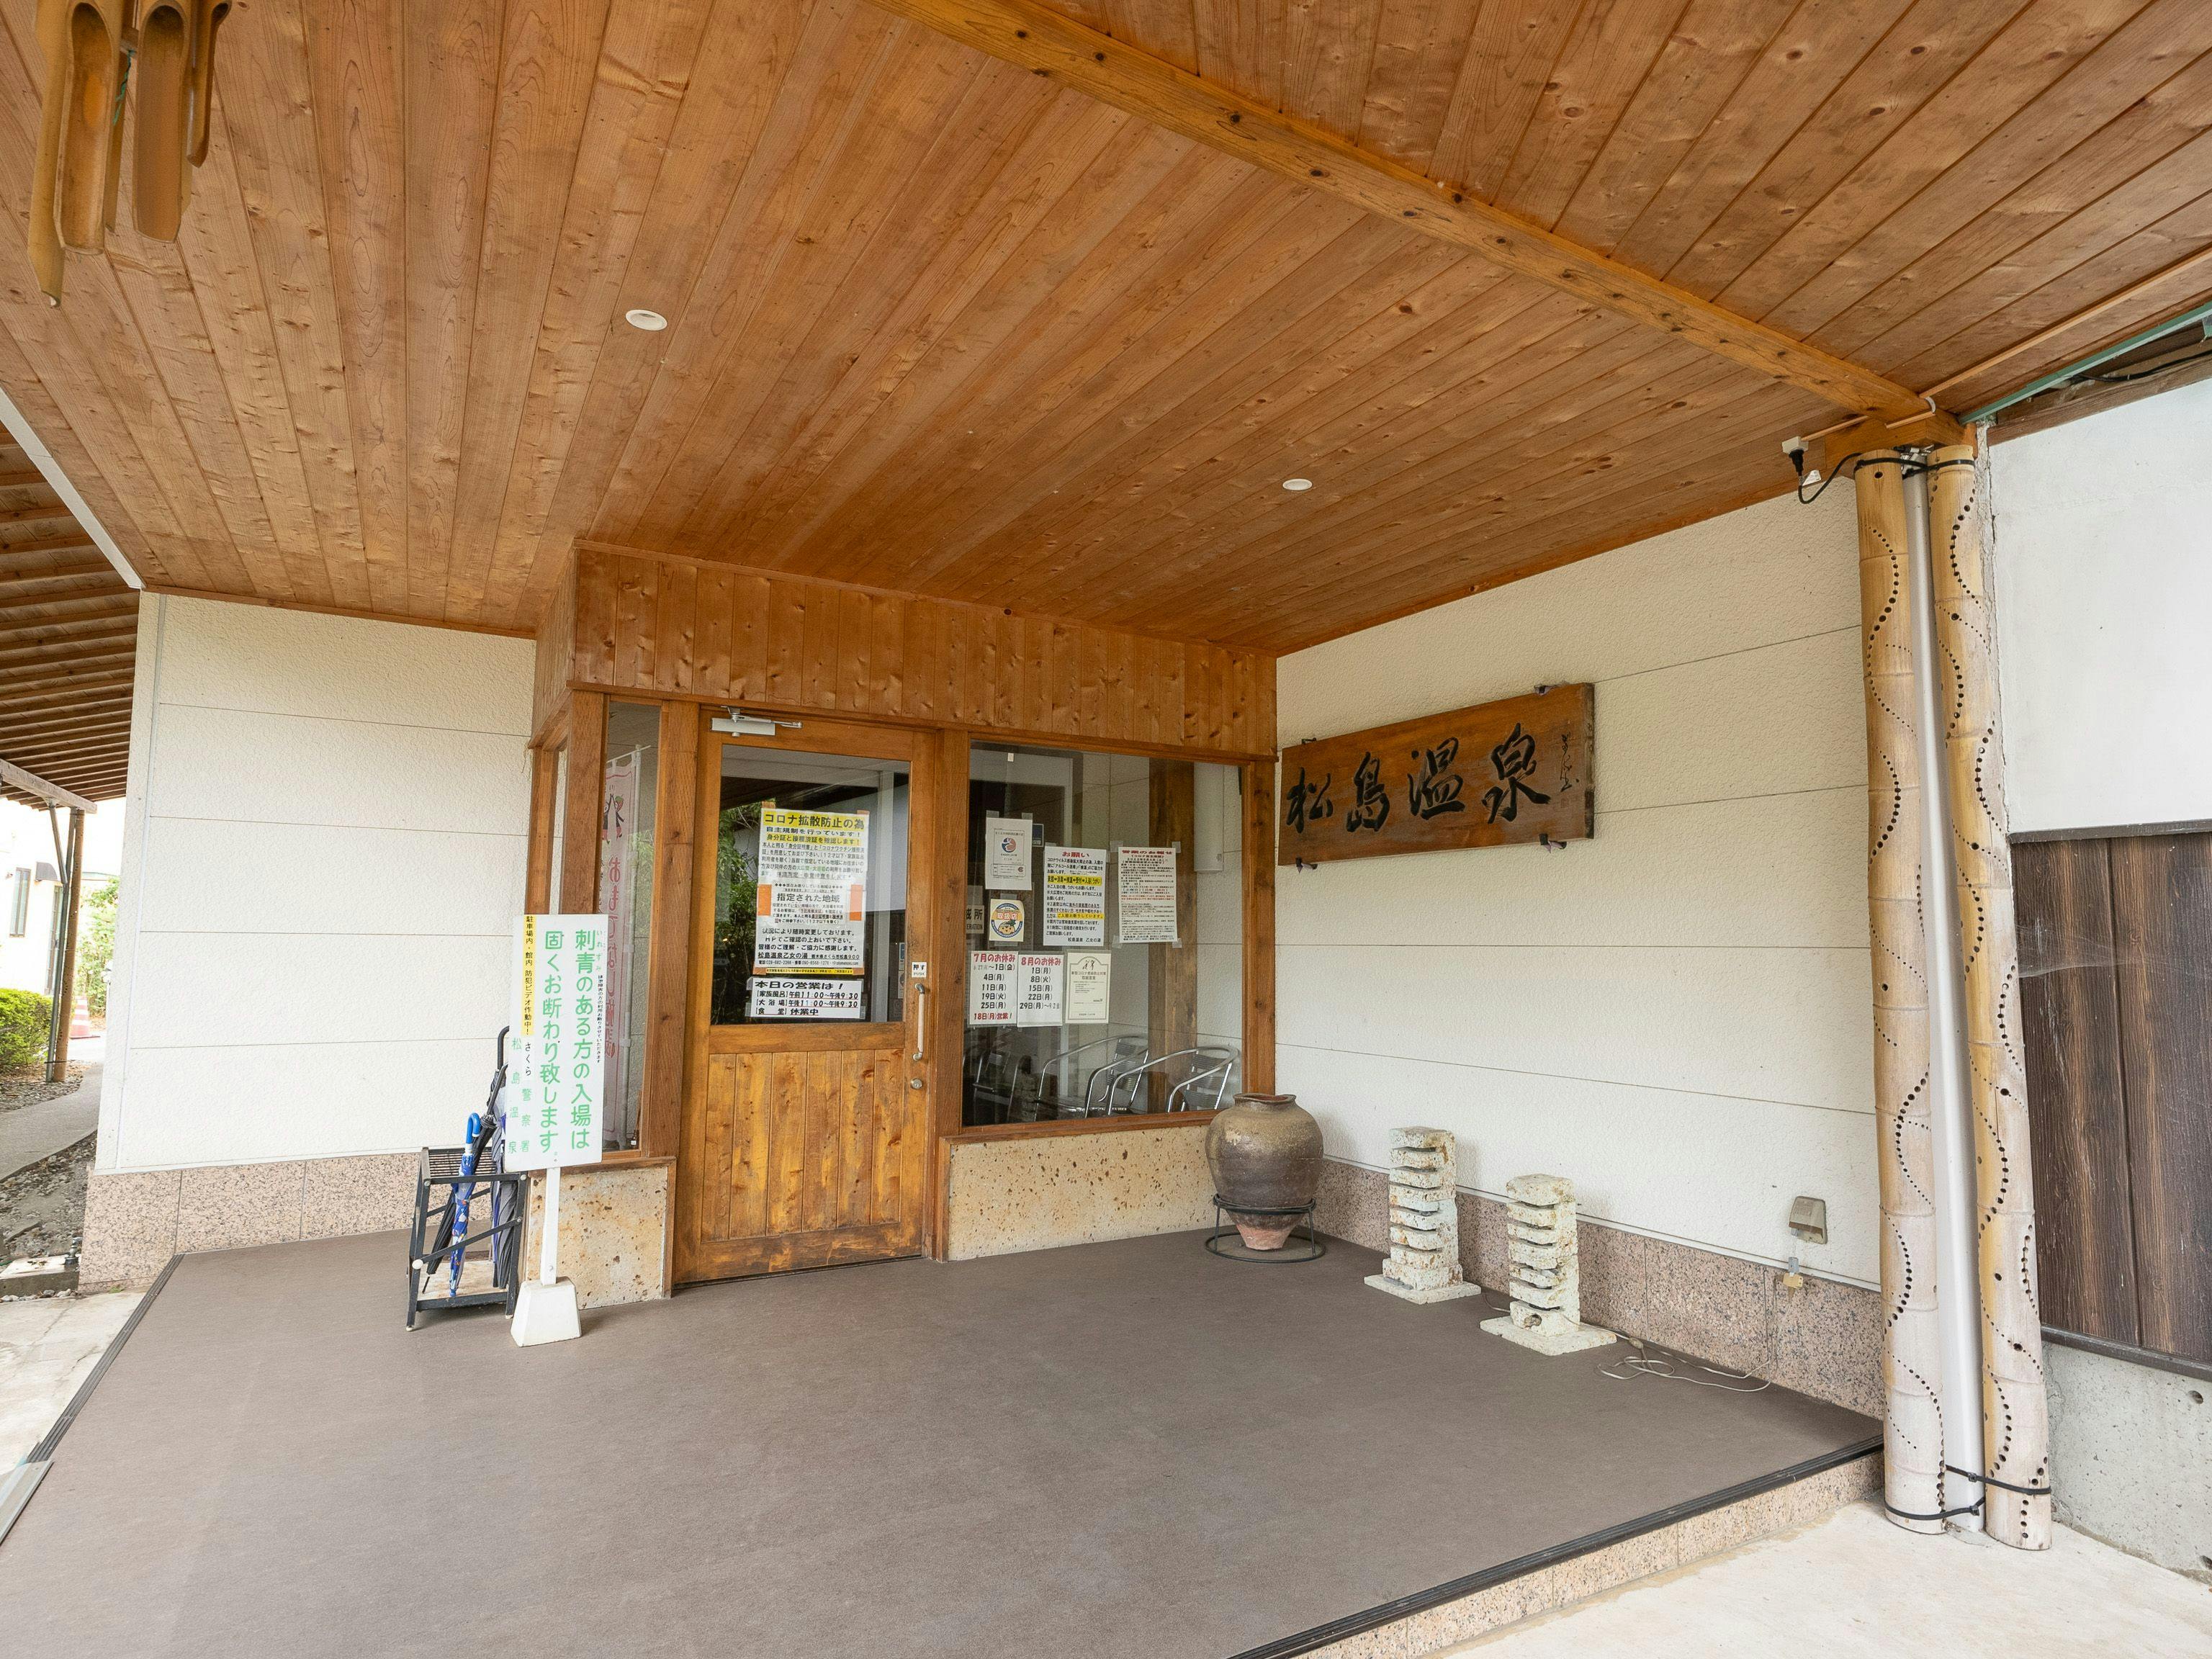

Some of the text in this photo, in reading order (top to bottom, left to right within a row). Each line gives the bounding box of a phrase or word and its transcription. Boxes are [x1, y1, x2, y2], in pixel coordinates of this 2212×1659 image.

[1286, 721, 1551, 834] 松島温泉
[765, 814, 864, 830] コロナ拡散防止の為
[777, 893, 840, 902] 指定された地域
[974, 953, 1015, 963] 7月のお休み
[1021, 957, 1061, 966] 8月のお休み
[571, 929, 595, 1149] 刺青のある方の入場は
[524, 1041, 533, 1076] さくら
[508, 1037, 523, 1154] 松島温泉
